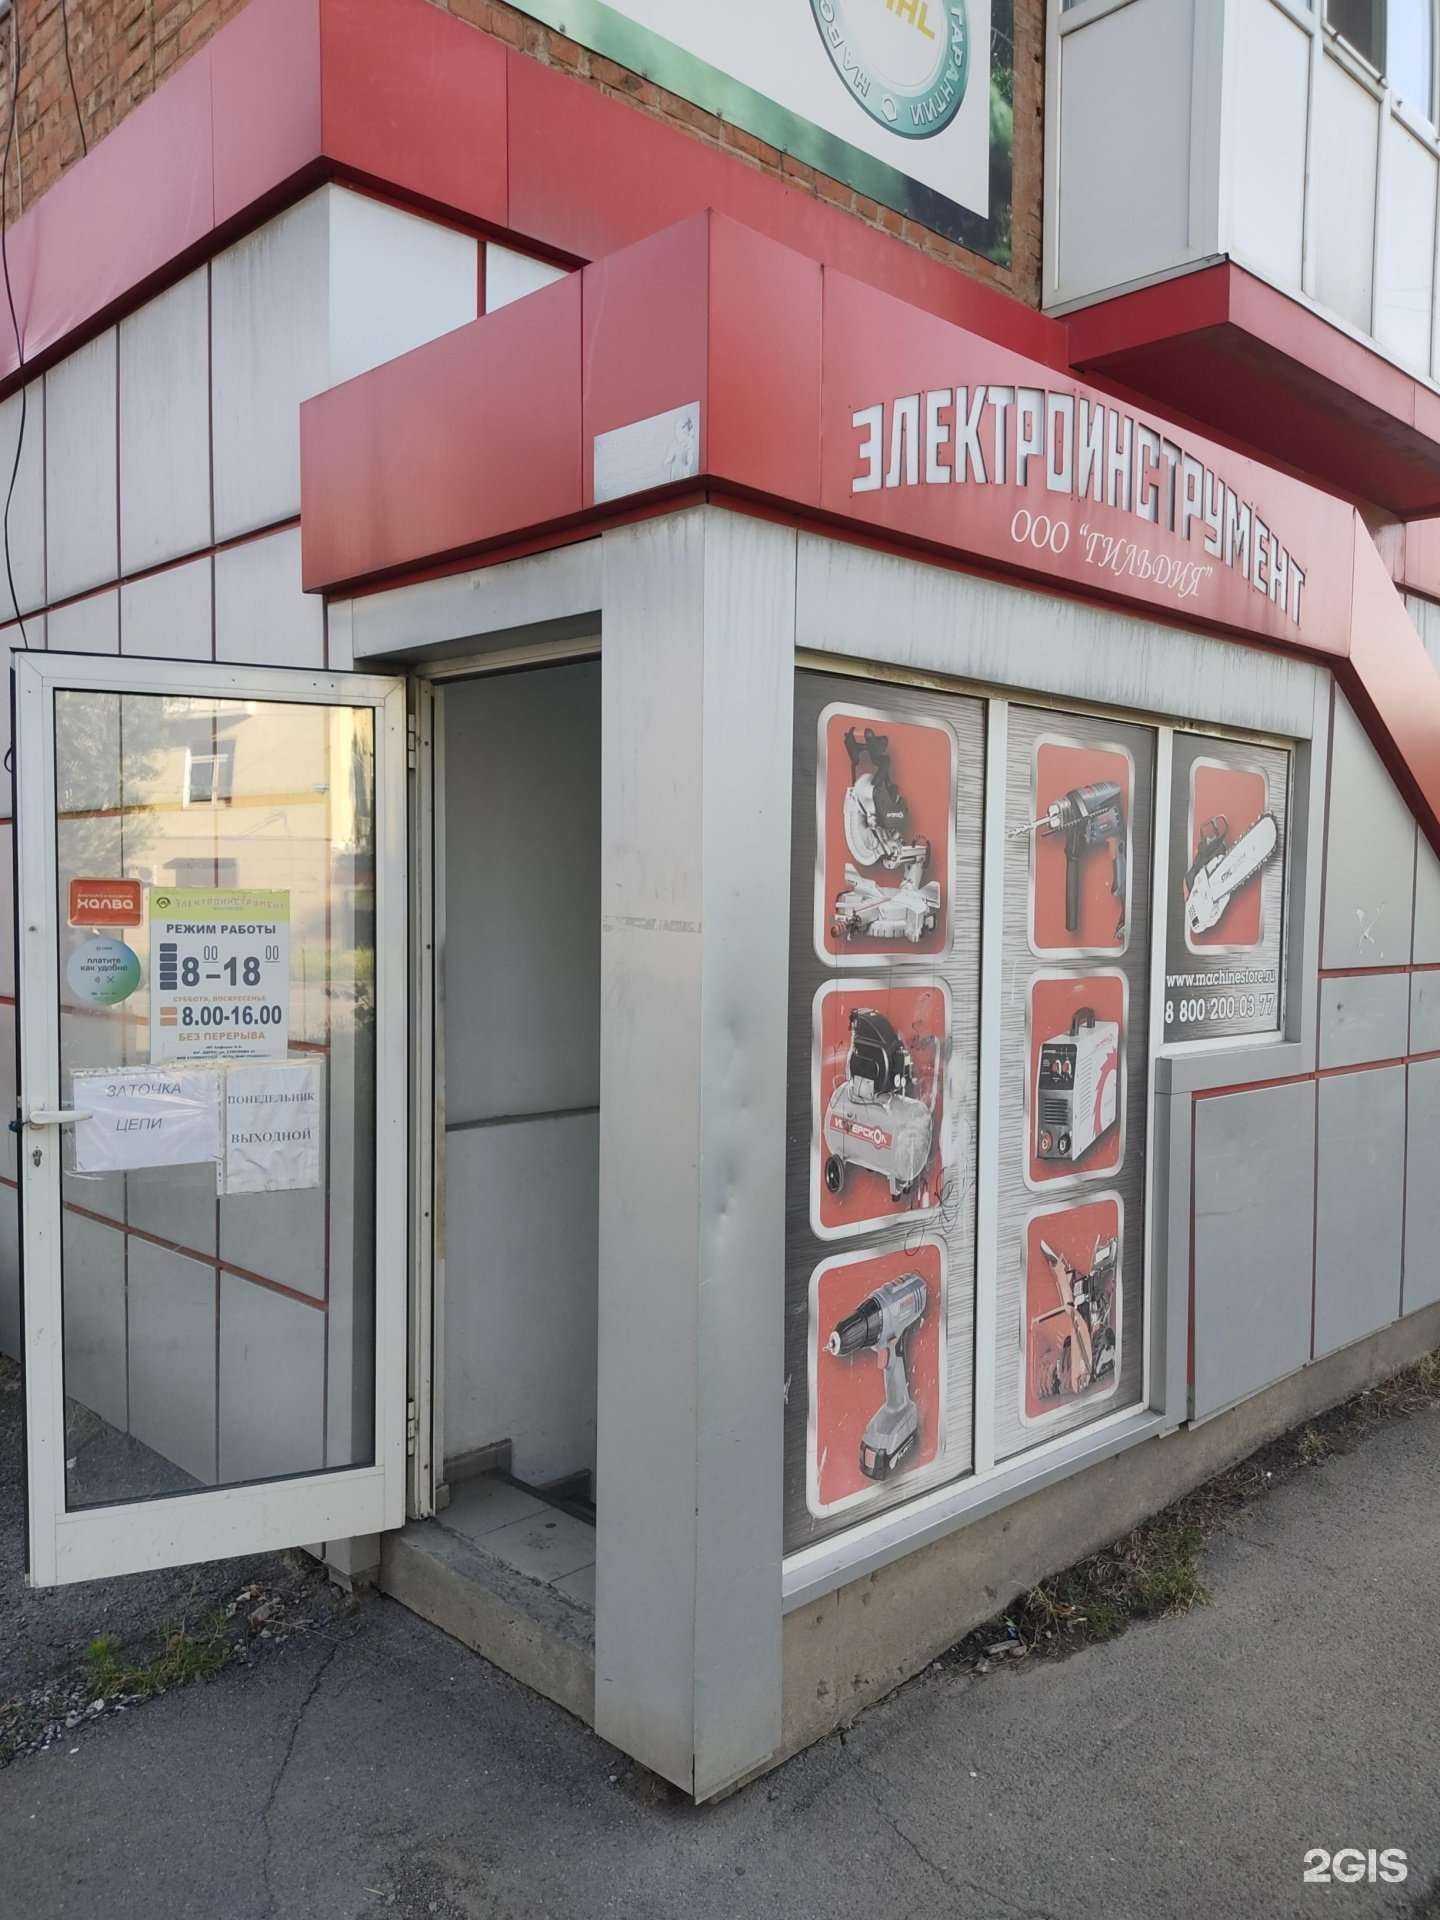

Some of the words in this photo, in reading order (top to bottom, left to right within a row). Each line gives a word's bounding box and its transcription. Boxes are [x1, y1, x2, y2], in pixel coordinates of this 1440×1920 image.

[851, 385, 1306, 625] ЭЛЕКТРОИНСТРУМЕНТ
[1010, 508, 1070, 554] ООО
[166, 923, 217, 935] РЕЖИМ
[220, 924, 277, 935] РАБОТЫ
[182, 1004, 282, 1026] 8.00-16.00
[1165, 1000, 1174, 1024] 8
[1179, 998, 1206, 1022] 800
[1209, 996, 1235, 1020] 200
[1239, 994, 1256, 1018] 03
[178, 1032, 201, 1042] БЕЗ
[203, 1031, 266, 1041] ПЕРЕРЫВА
[106, 1083, 182, 1098] ЗАТОЧКА
[227, 1092, 315, 1106] ПОНЕДЕЛЬНИК
[115, 1117, 163, 1133] ЦЕПИ
[231, 1128, 312, 1145] ВЫХОДНОЙ
